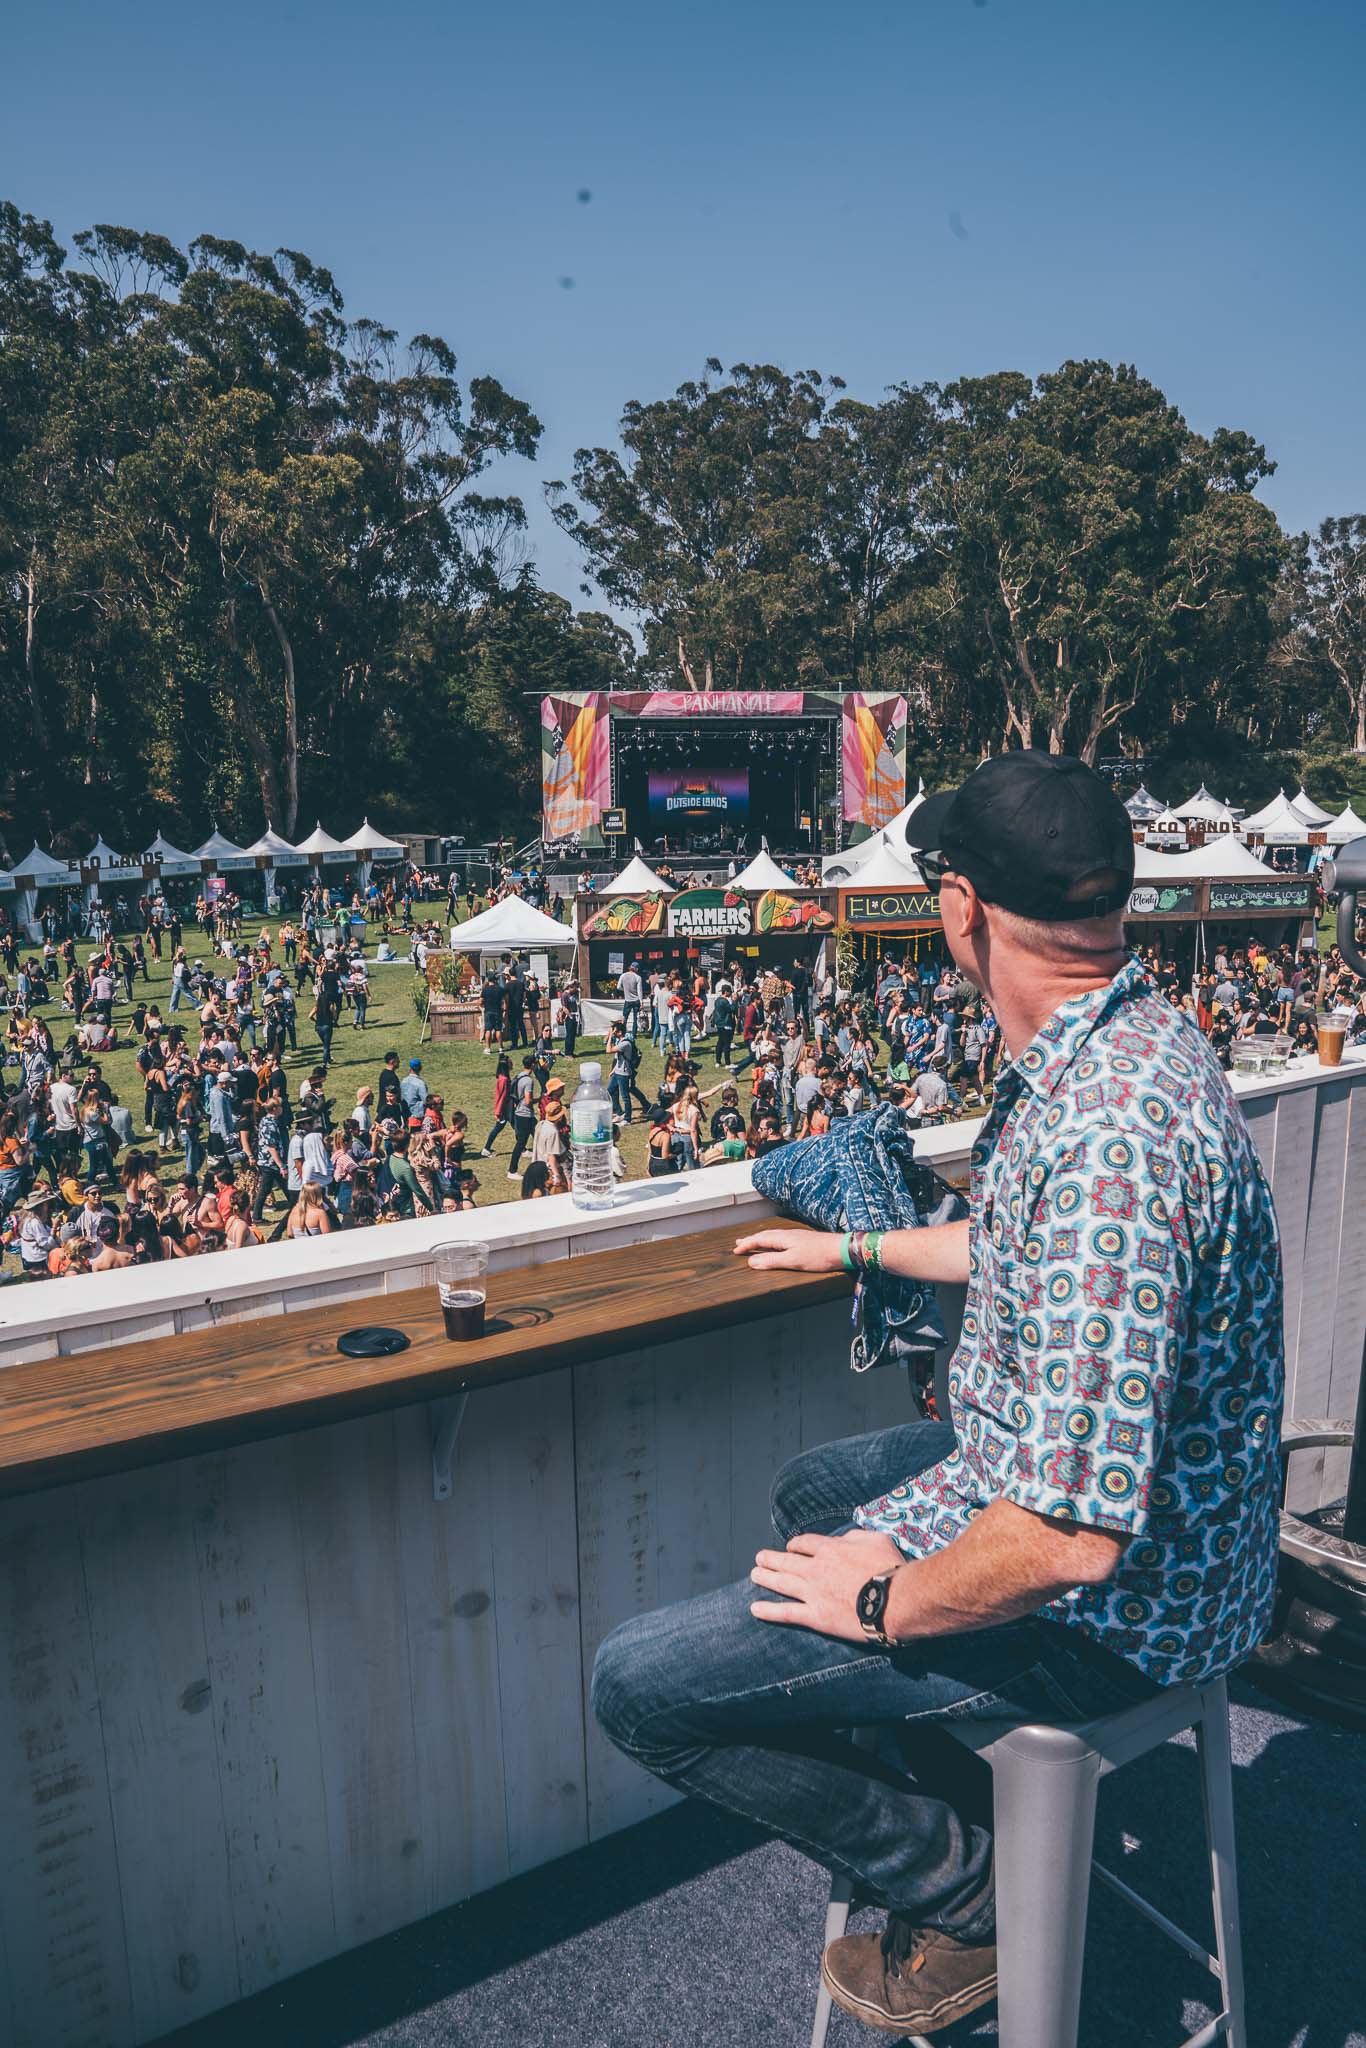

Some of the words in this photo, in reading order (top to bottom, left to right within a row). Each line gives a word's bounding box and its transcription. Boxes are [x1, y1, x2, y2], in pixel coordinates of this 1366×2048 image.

[666, 797, 701, 811] OUTSIDE
[702, 797, 728, 809] LANDS
[1147, 822, 1178, 833] ECO
[1186, 821, 1242, 833] LANDS
[68, 855, 102, 872] ECO
[108, 852, 164, 869] LANDS
[849, 896, 942, 917] FLOWE
[1131, 893, 1158, 907] Plenty
[667, 904, 751, 937] FARMERS
[681, 925, 739, 936] MARKET
